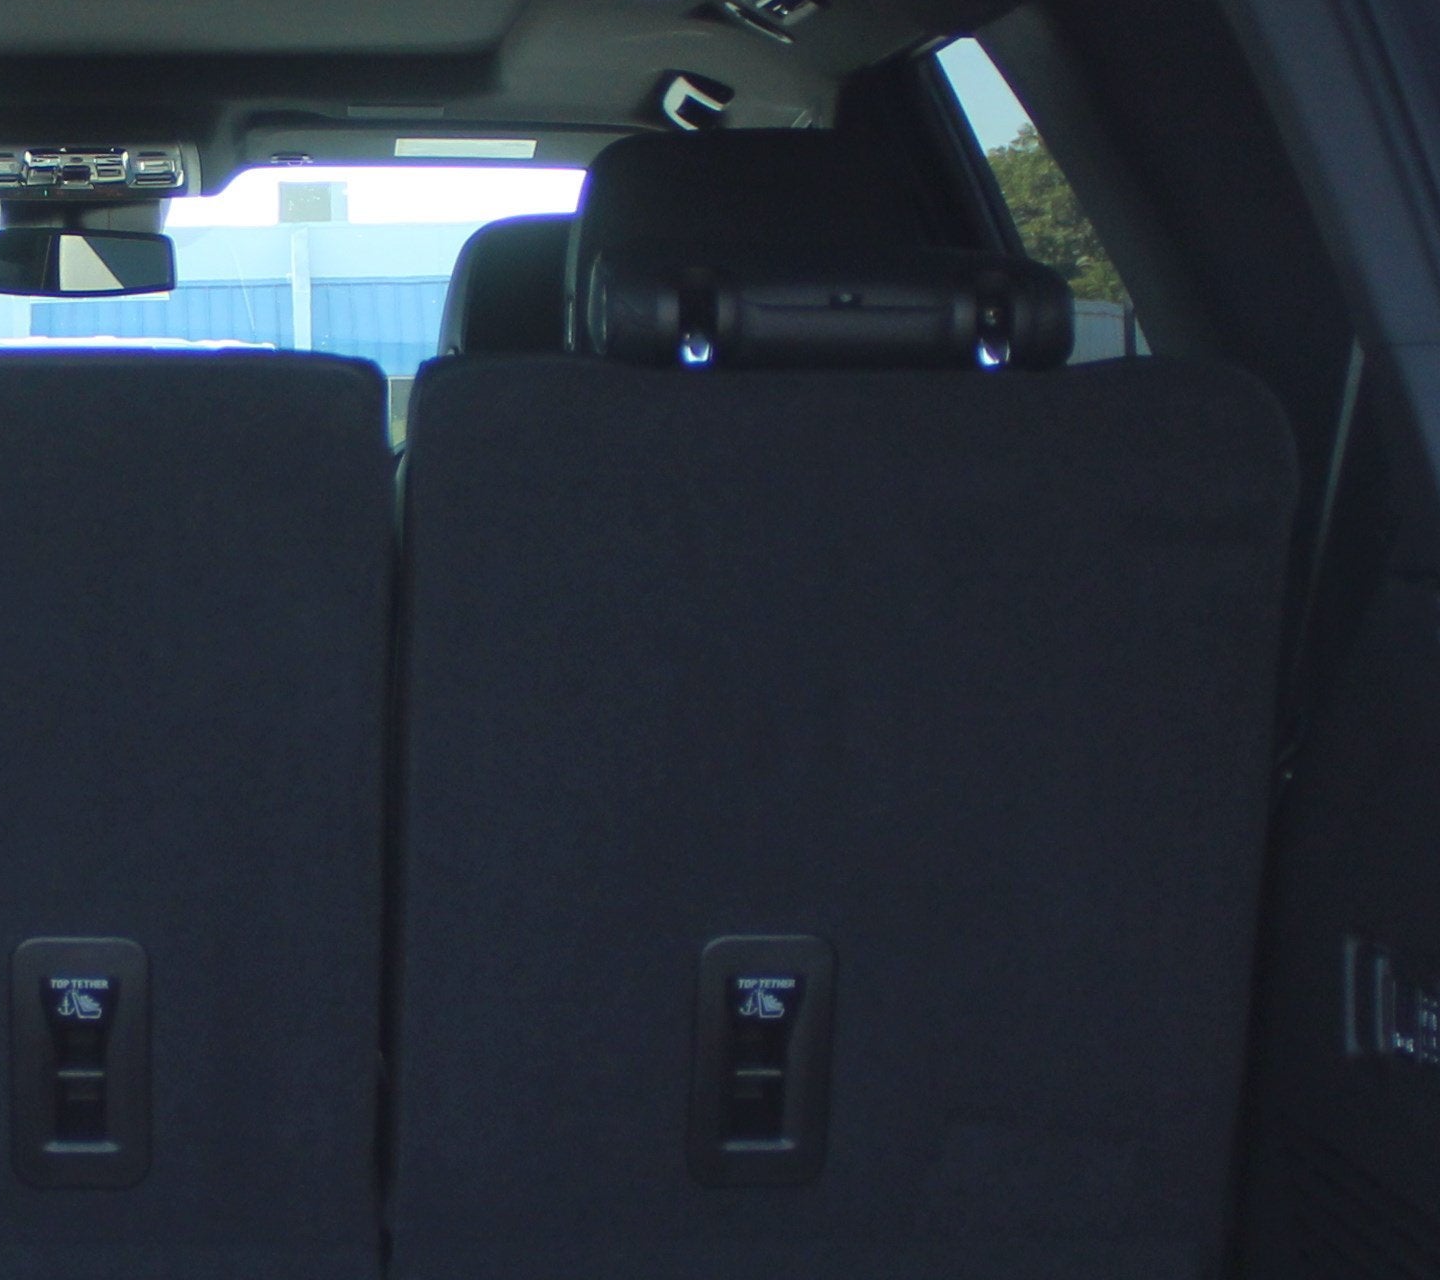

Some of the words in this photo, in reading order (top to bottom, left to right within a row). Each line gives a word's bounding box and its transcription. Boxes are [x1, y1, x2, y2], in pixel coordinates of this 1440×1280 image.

[50, 979, 70, 990] TOP
[71, 979, 109, 990] TETHER
[738, 979, 758, 990] TOP
[759, 979, 796, 990] TETHER
